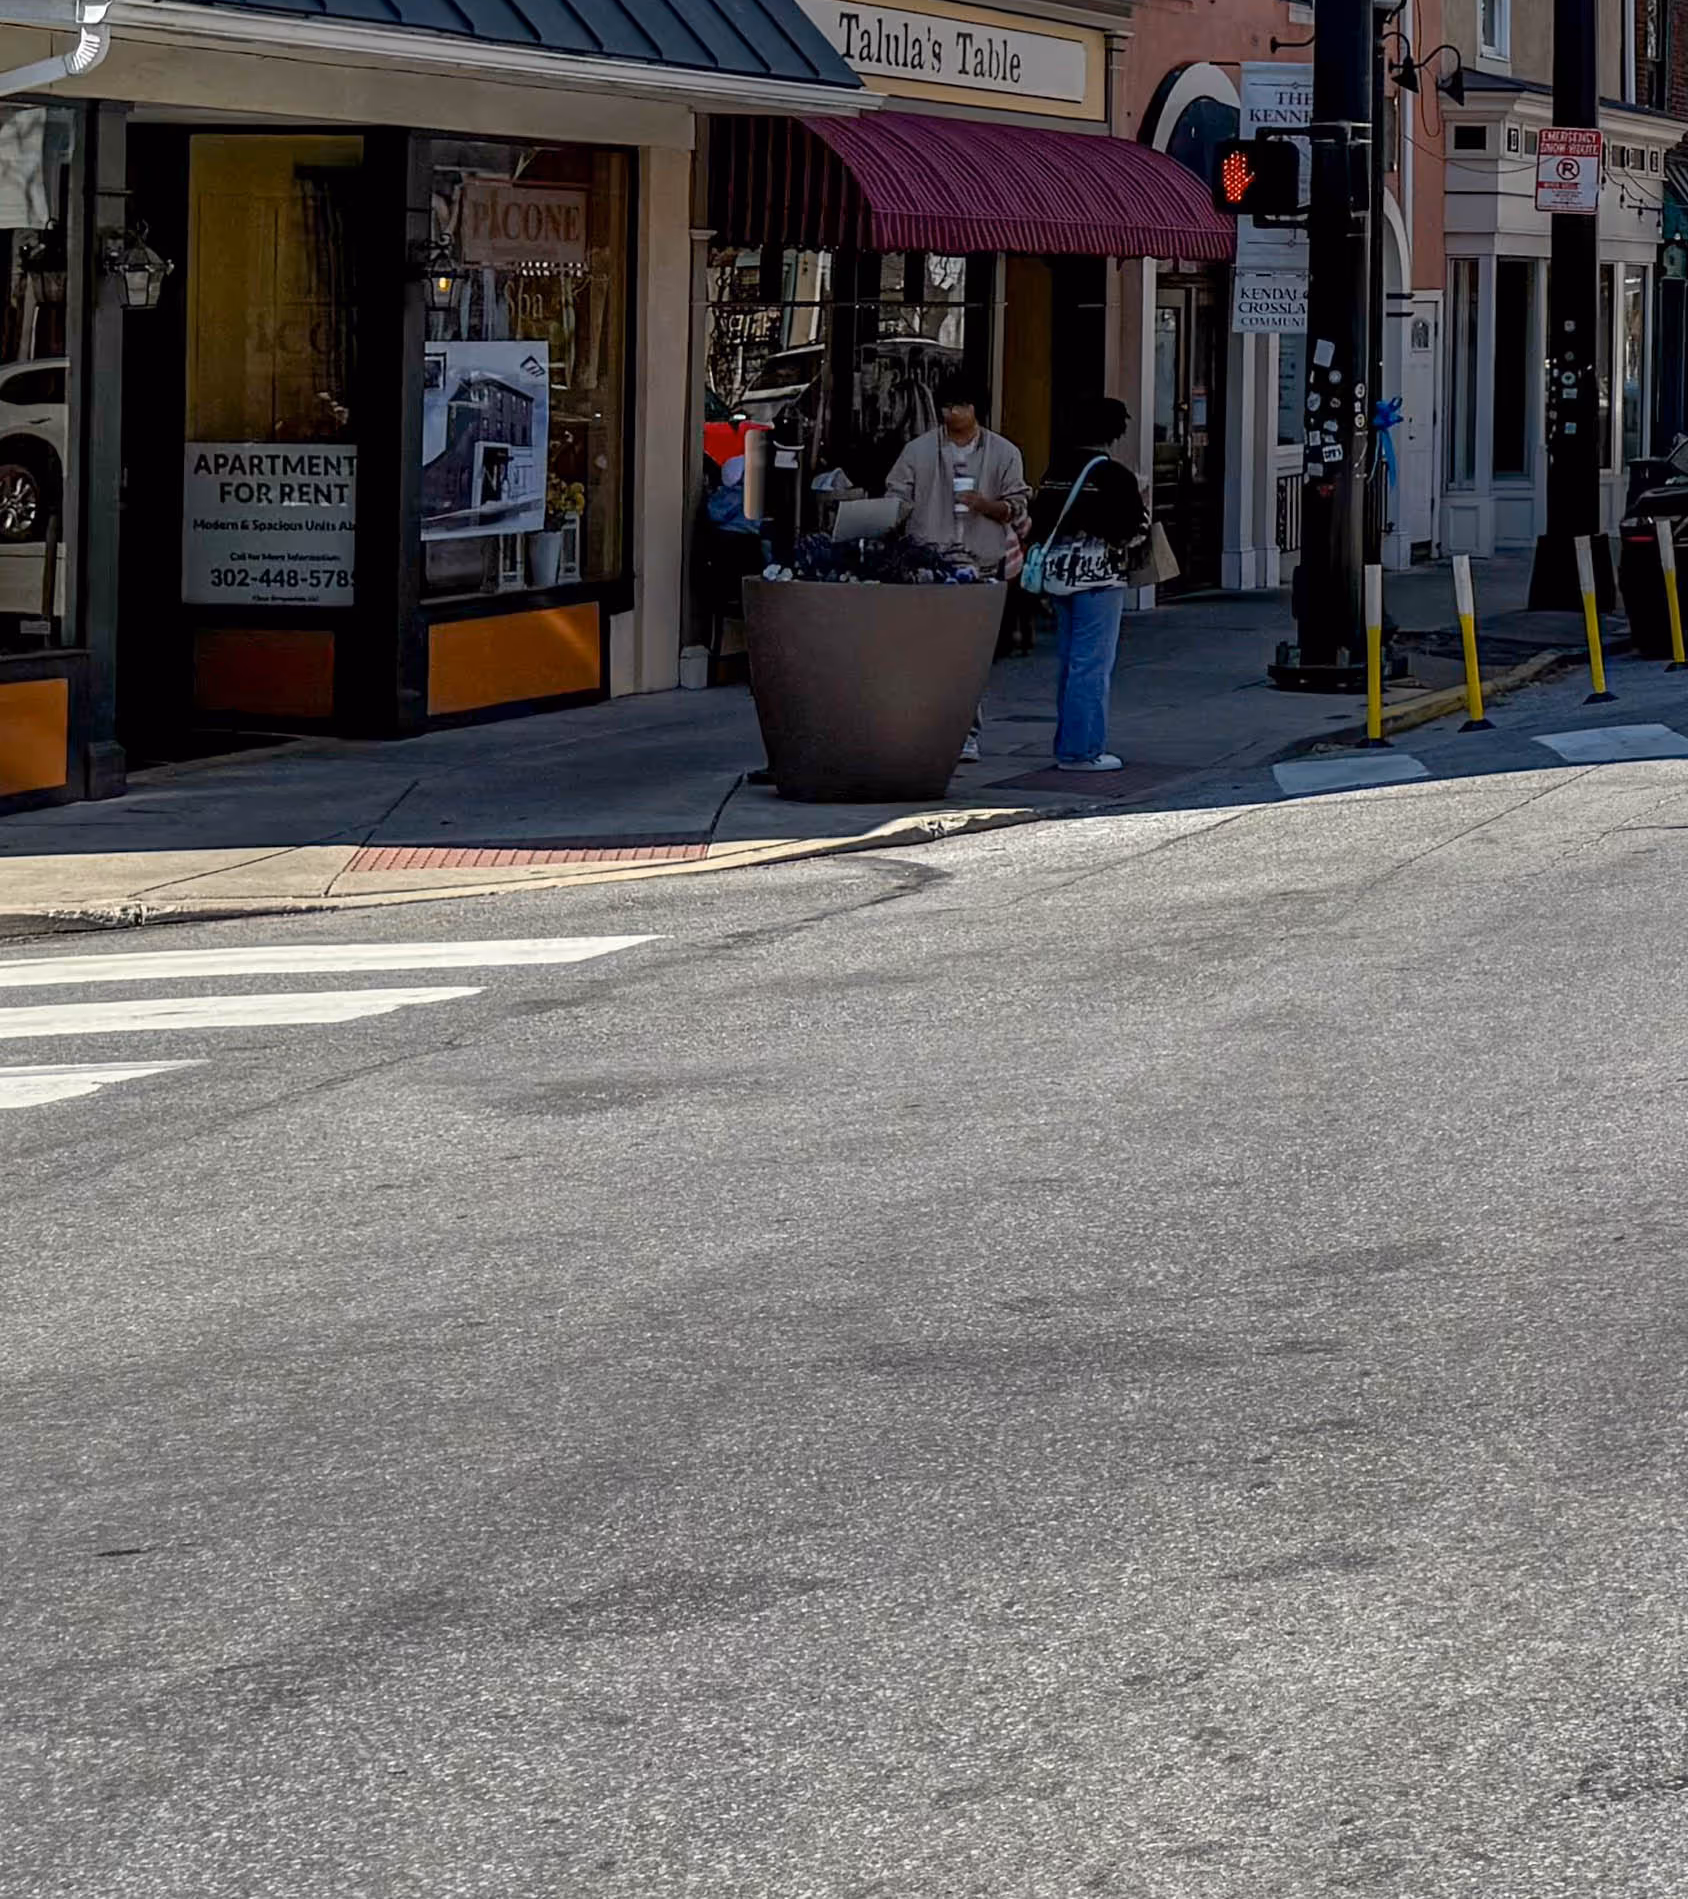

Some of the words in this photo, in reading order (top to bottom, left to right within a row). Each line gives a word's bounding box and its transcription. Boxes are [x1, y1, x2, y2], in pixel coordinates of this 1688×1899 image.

[839, 12, 943, 73] Talula's
[956, 31, 1021, 83] Table
[1248, 108, 1310, 123] KENN
[1238, 302, 1306, 315] CROSSLA
[193, 453, 359, 477] APARTMENT
[219, 482, 273, 504] FOR
[280, 482, 349, 505] RENT
[193, 519, 239, 531] Modern
[252, 519, 303, 532] Spacious
[305, 519, 336, 532] Units
